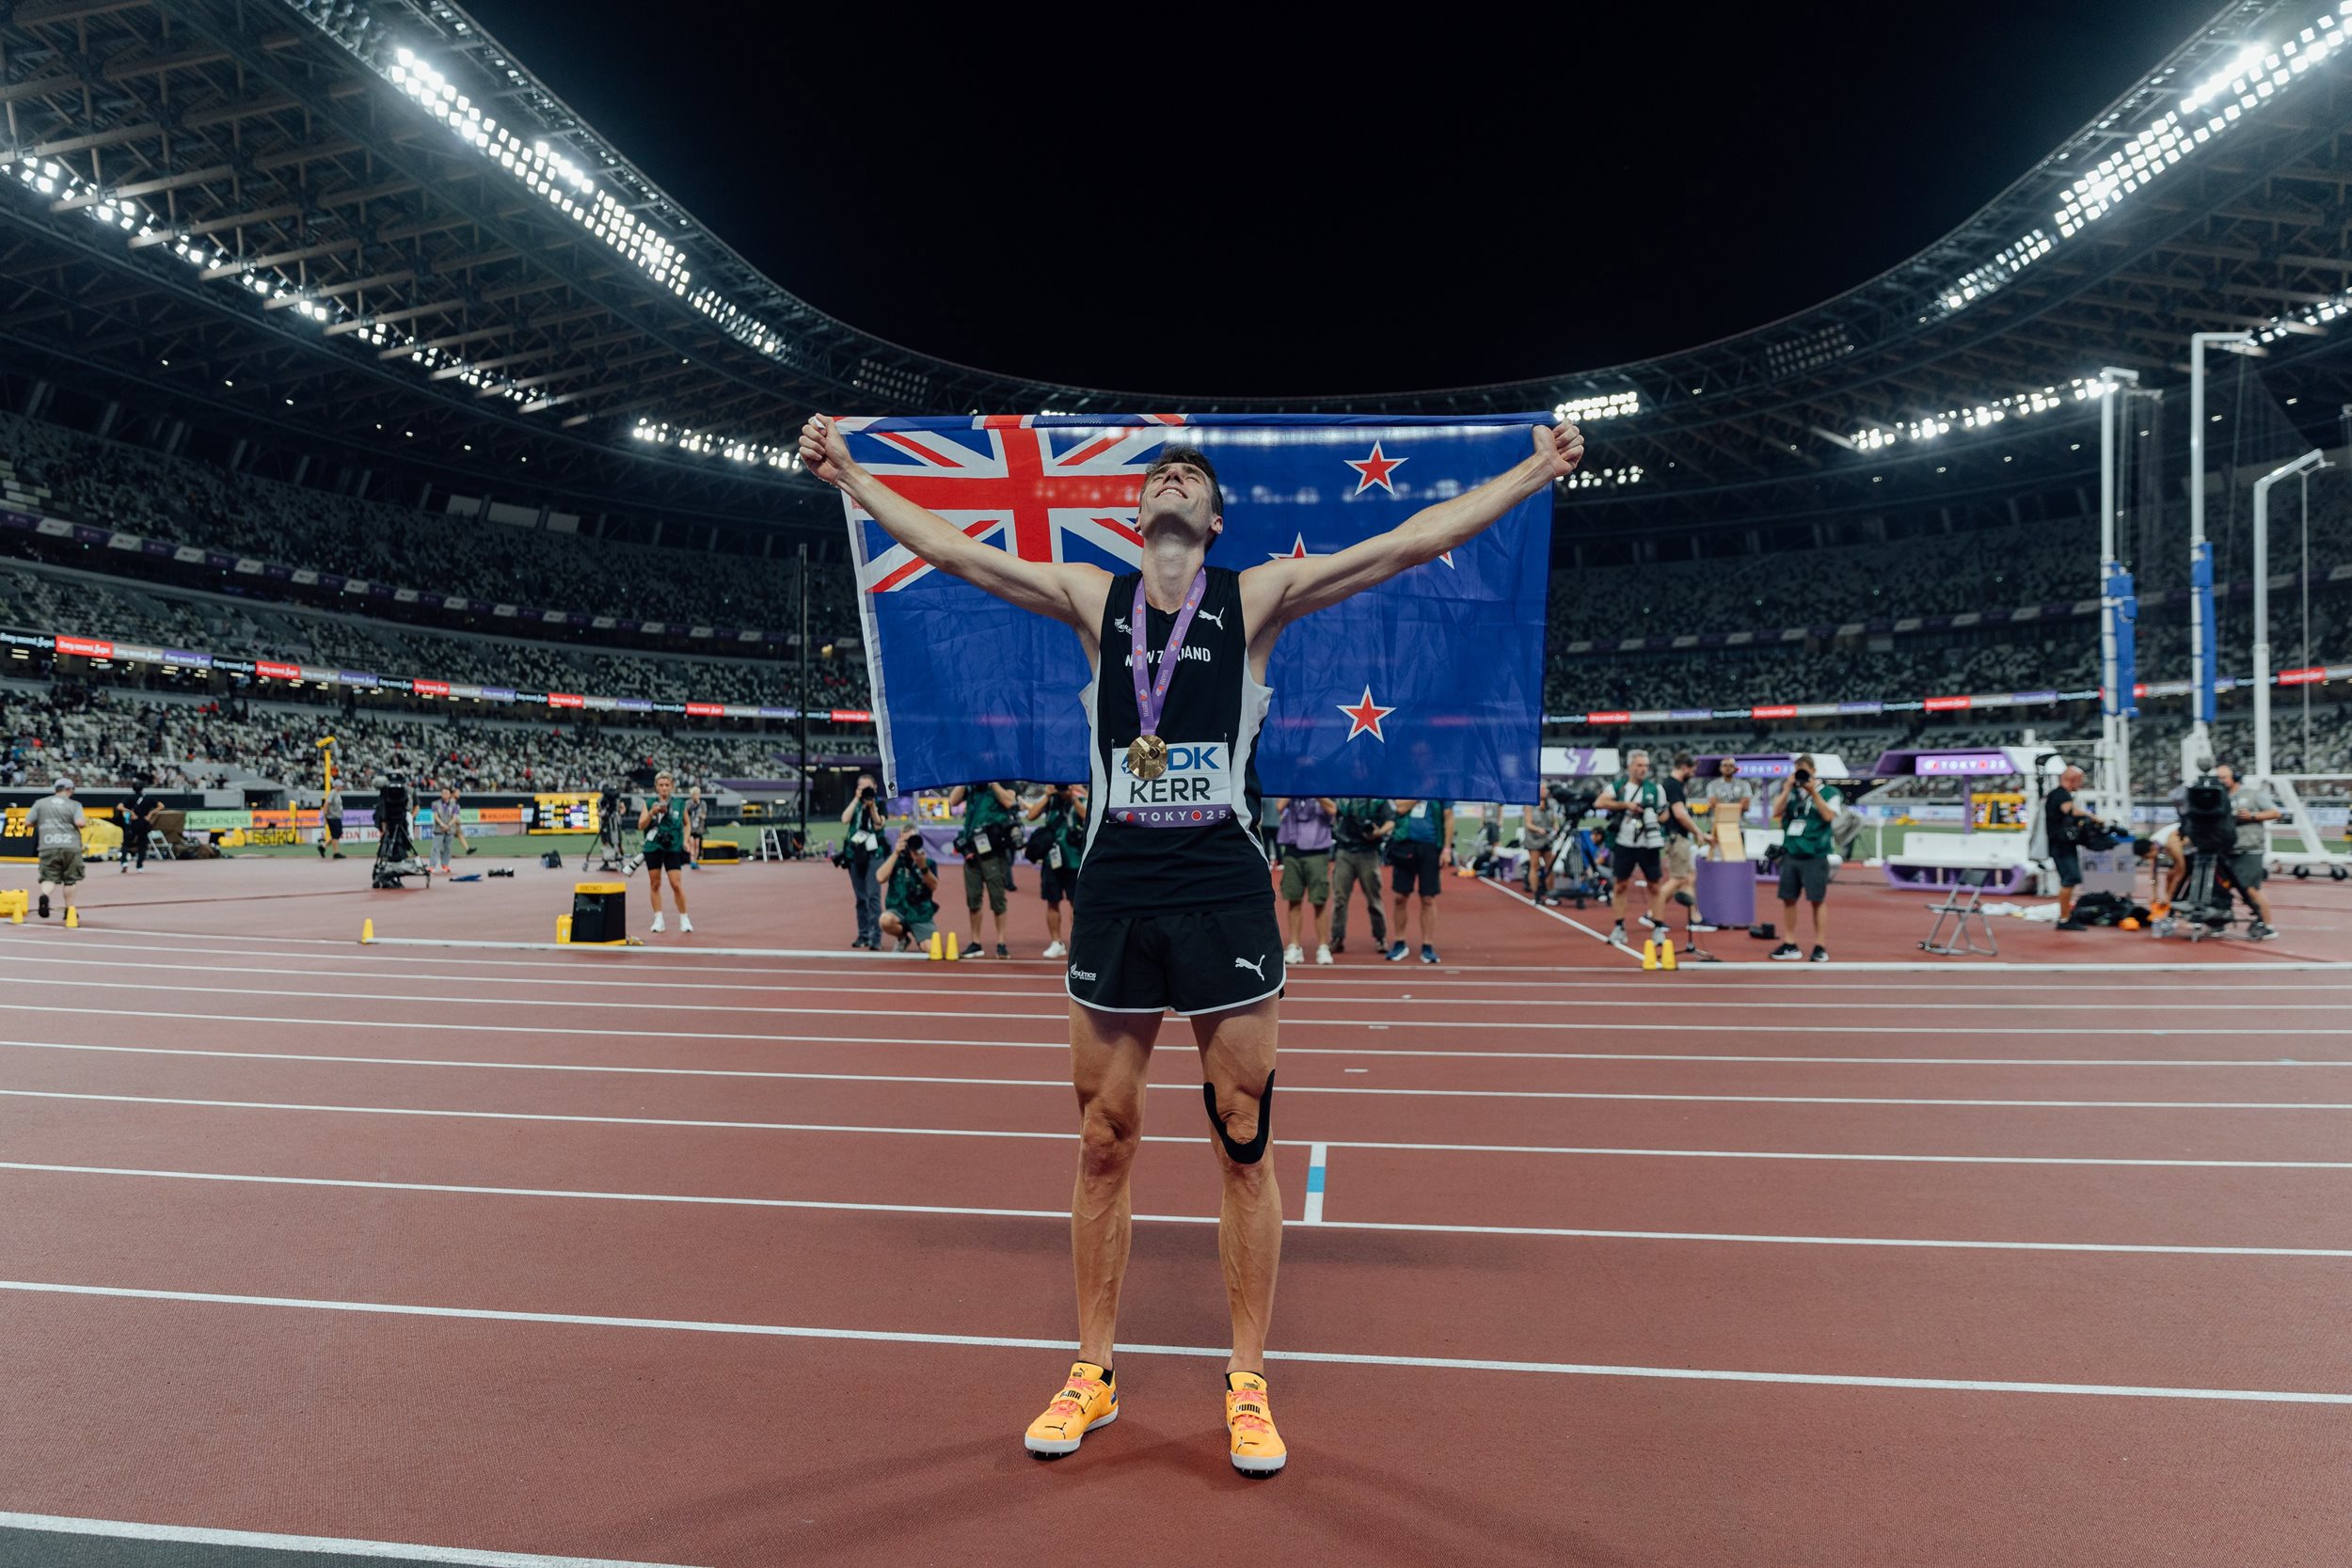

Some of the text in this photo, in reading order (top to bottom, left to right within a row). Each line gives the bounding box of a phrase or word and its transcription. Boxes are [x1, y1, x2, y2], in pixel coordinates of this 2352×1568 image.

[1125, 650, 1154, 667] NW
[1167, 747, 1220, 771] DK
[1130, 777, 1211, 803] KERR
[43, 833, 72, 844] 062
